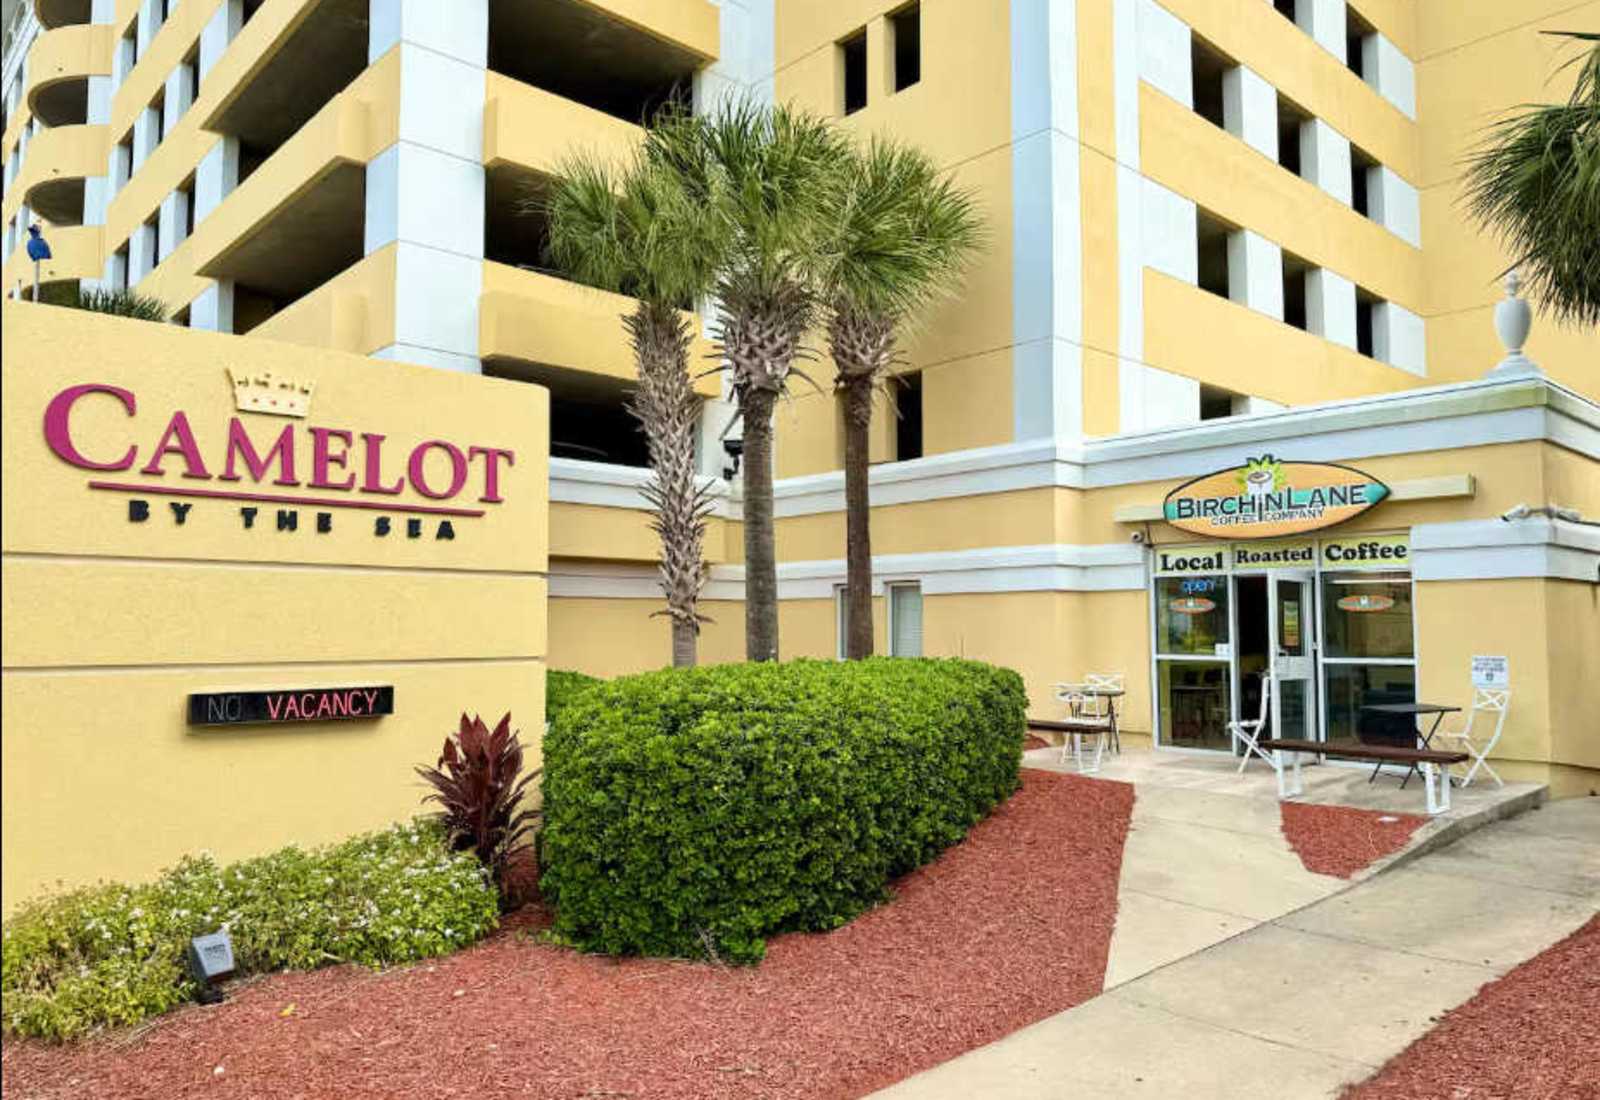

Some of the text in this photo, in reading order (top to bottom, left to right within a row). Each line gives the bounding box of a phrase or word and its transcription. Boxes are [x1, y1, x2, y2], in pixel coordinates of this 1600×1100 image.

[43, 383, 515, 503] CAMELOT
[129, 500, 456, 540] BY THE SEA
[1211, 508, 1323, 527] COFFEE COMPANY
[1160, 542, 1408, 571] Local Roasted Coffee
[207, 689, 379, 722] NO VACANCY
